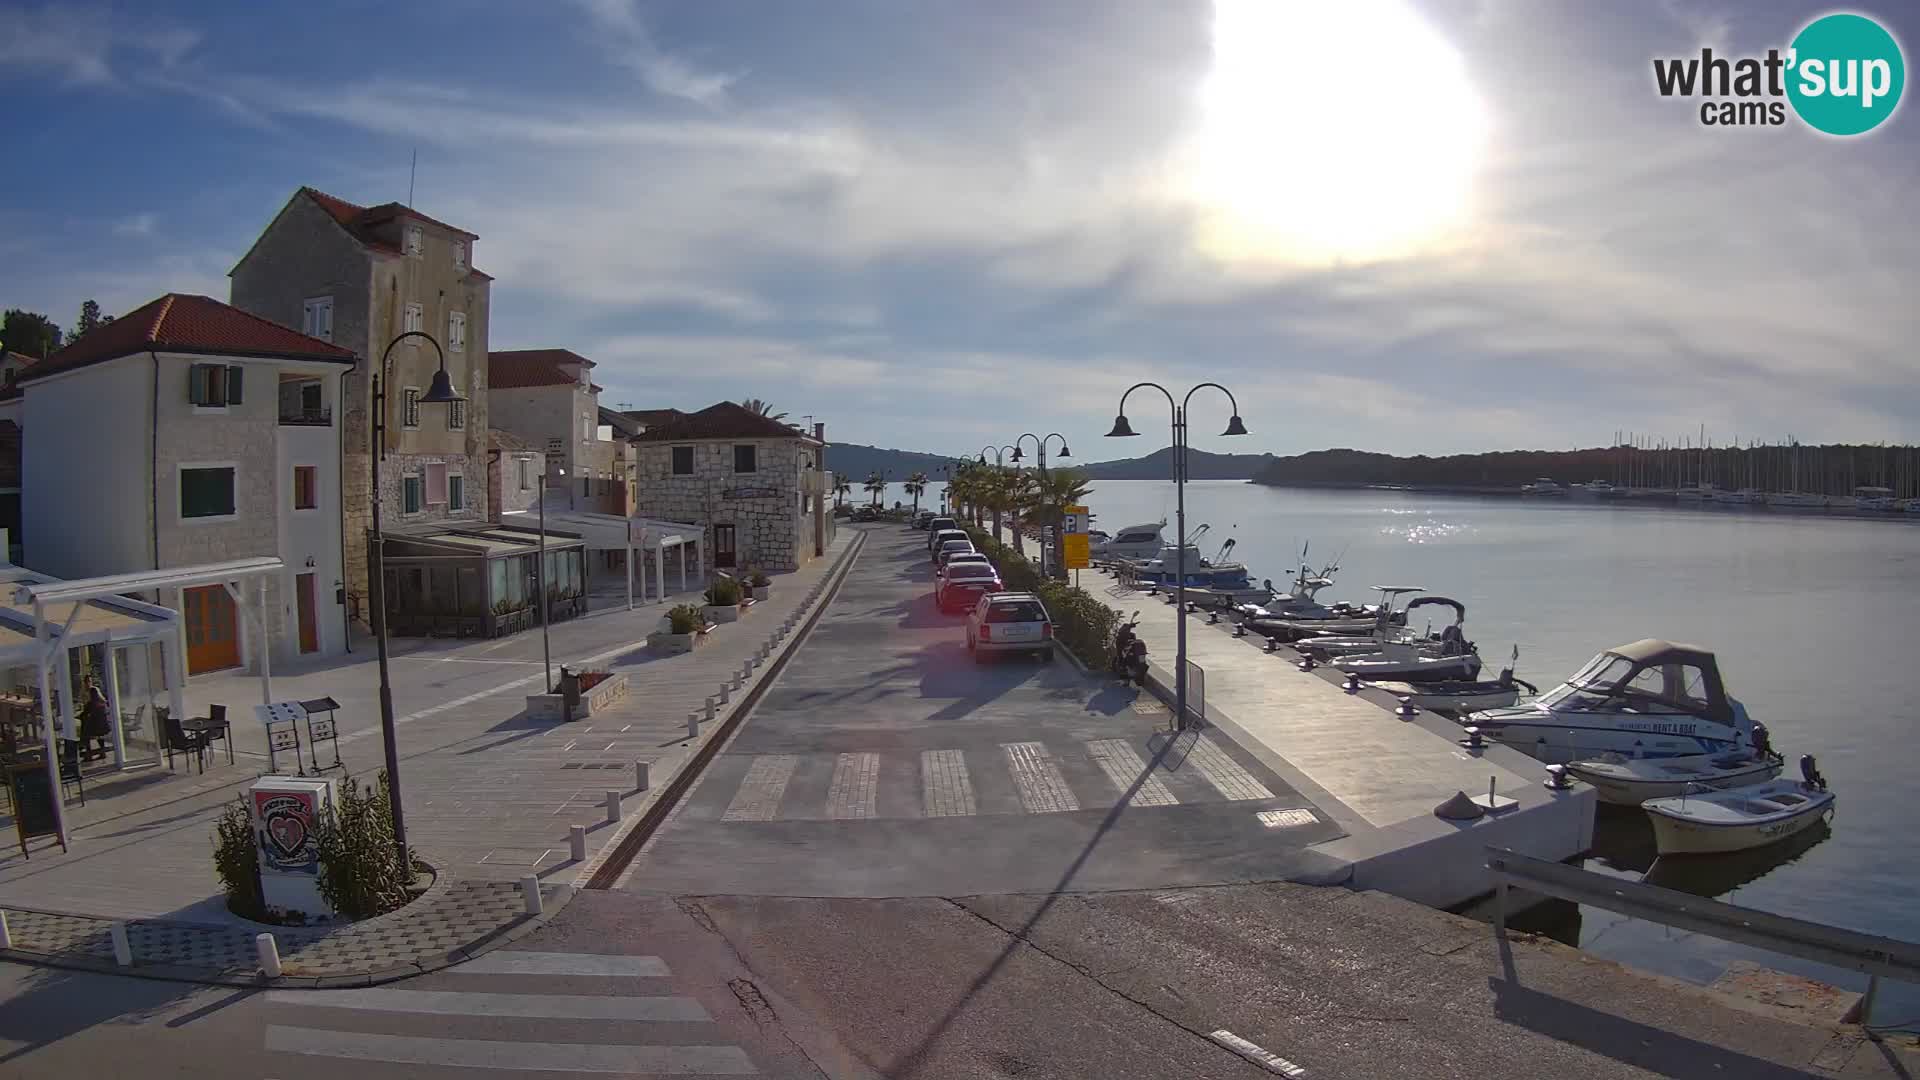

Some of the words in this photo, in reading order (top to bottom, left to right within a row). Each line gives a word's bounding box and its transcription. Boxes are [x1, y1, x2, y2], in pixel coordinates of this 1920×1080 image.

[1066, 516, 1076, 531] P
[1653, 723, 1672, 733] RENT
[1679, 724, 1697, 734] BOAT
